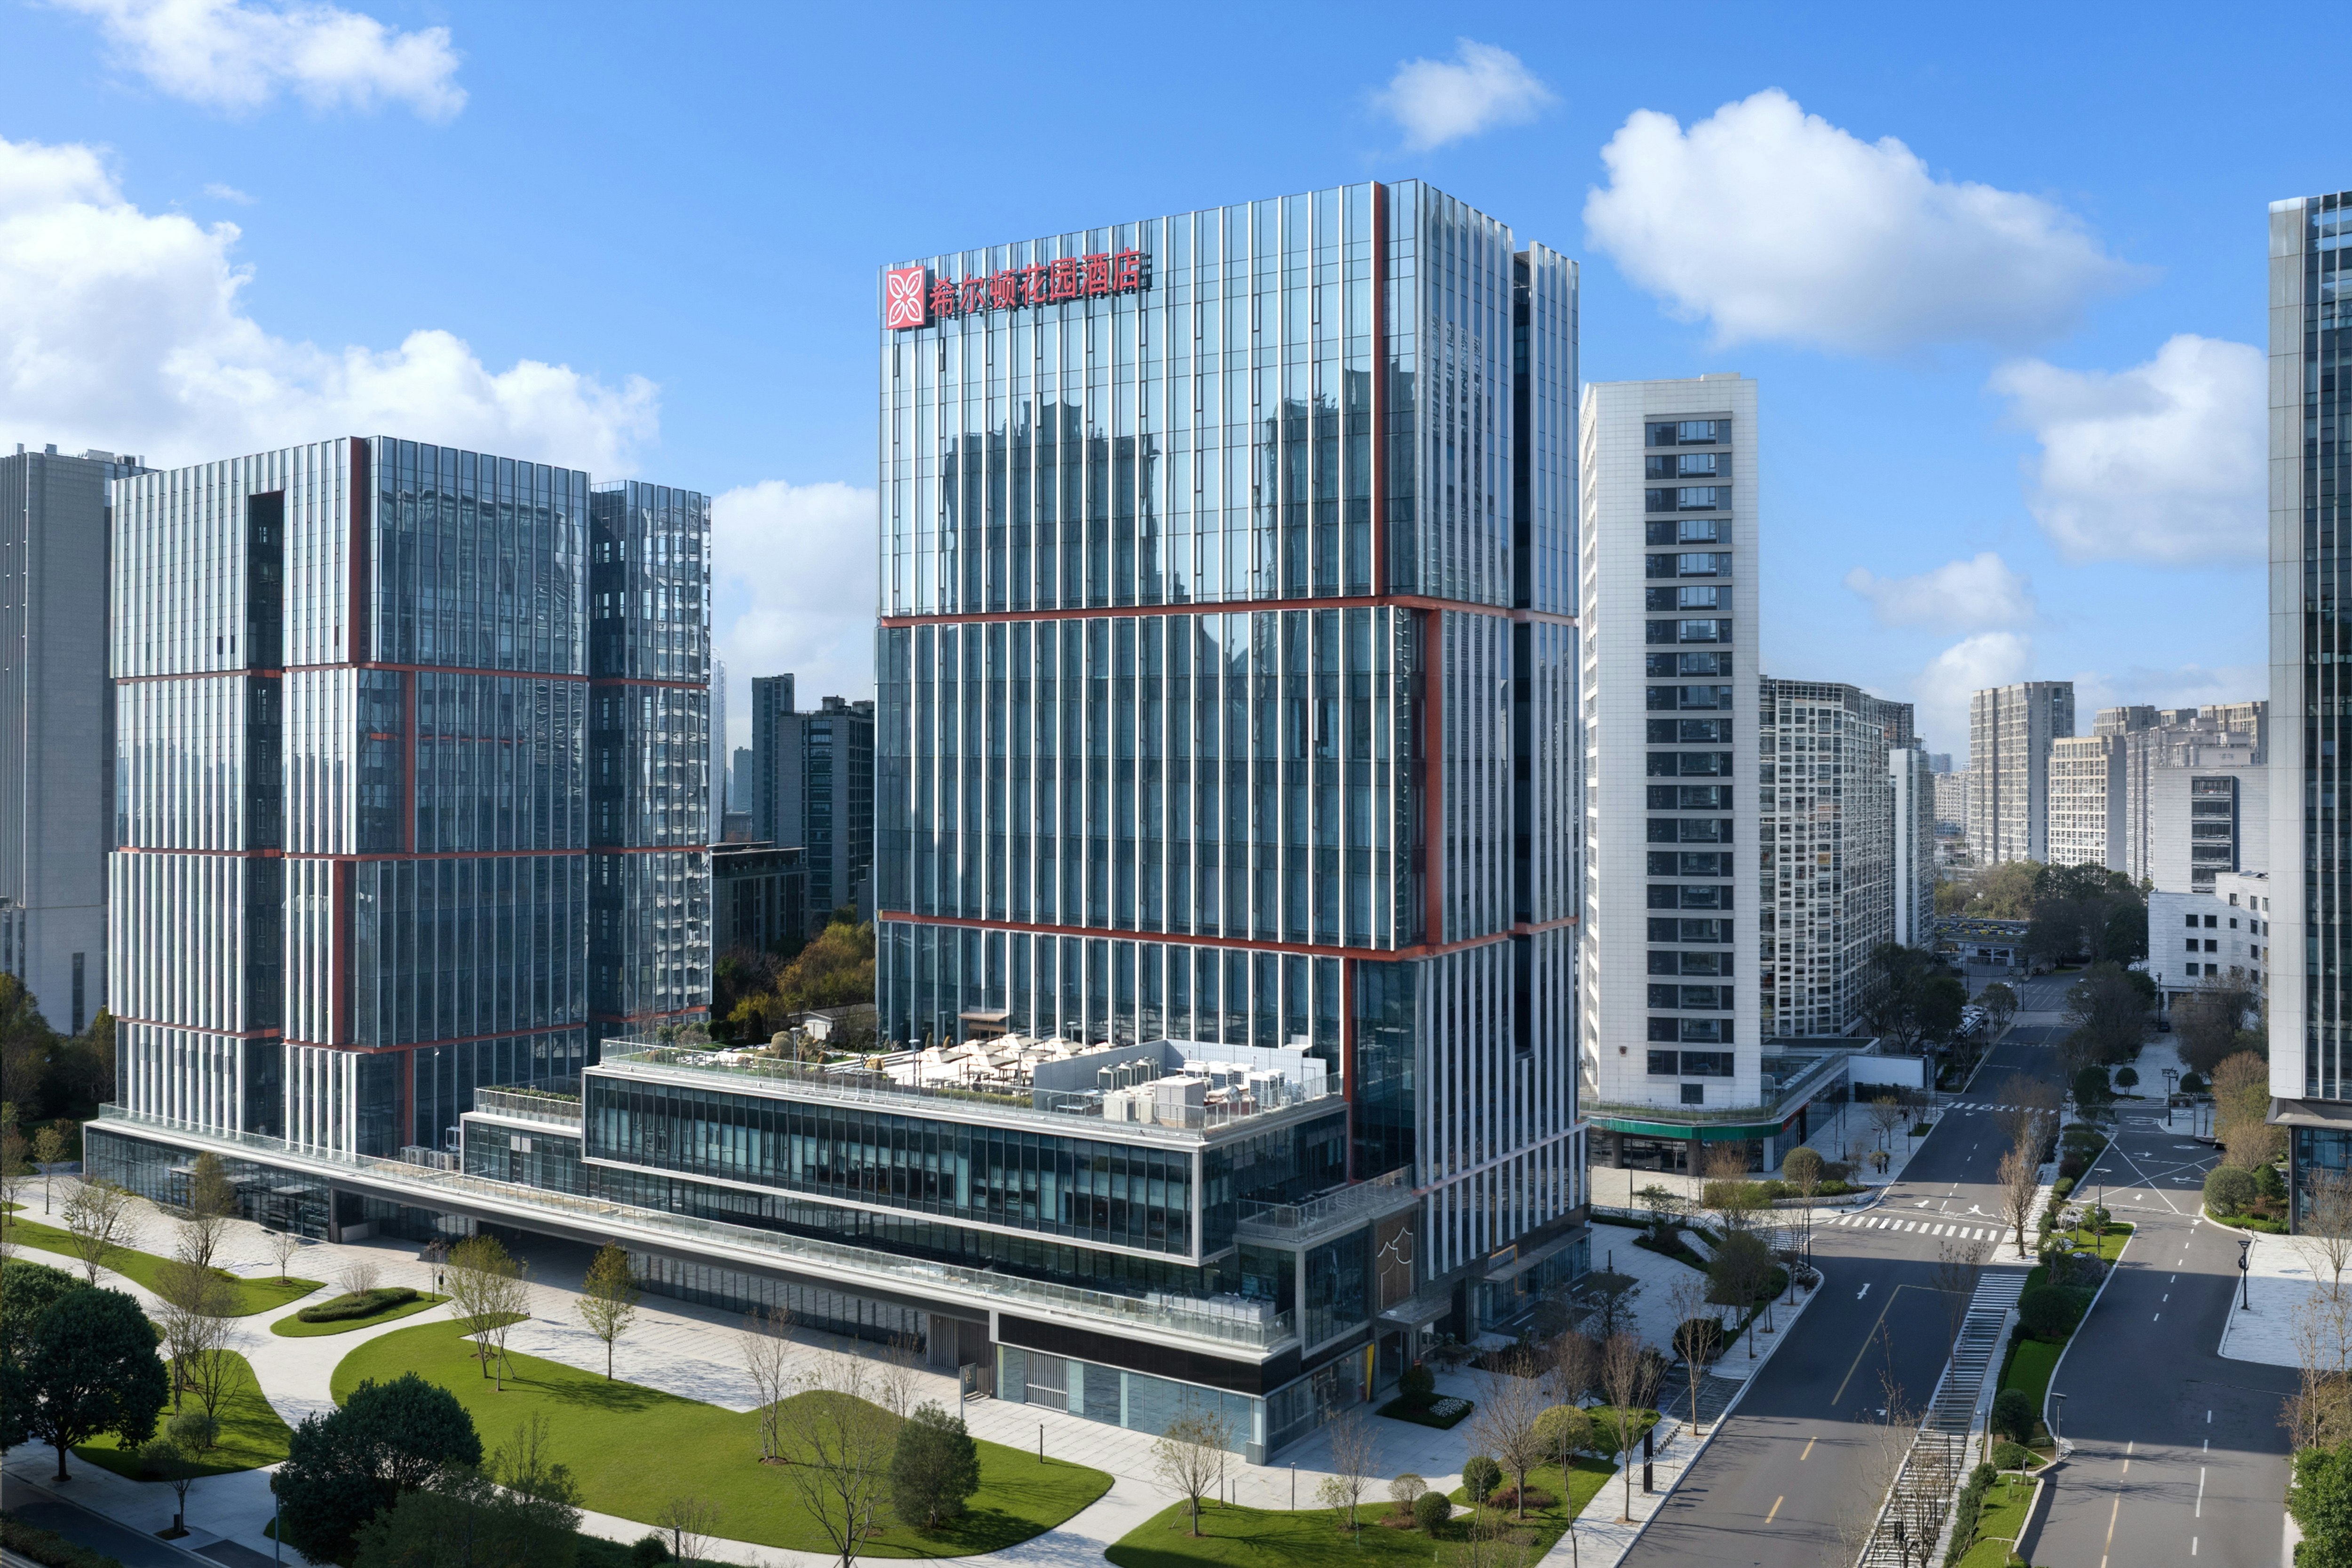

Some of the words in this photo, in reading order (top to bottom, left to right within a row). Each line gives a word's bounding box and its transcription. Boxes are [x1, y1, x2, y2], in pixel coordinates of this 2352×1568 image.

[930, 246, 1140, 317] 希尔顿花园酒店
